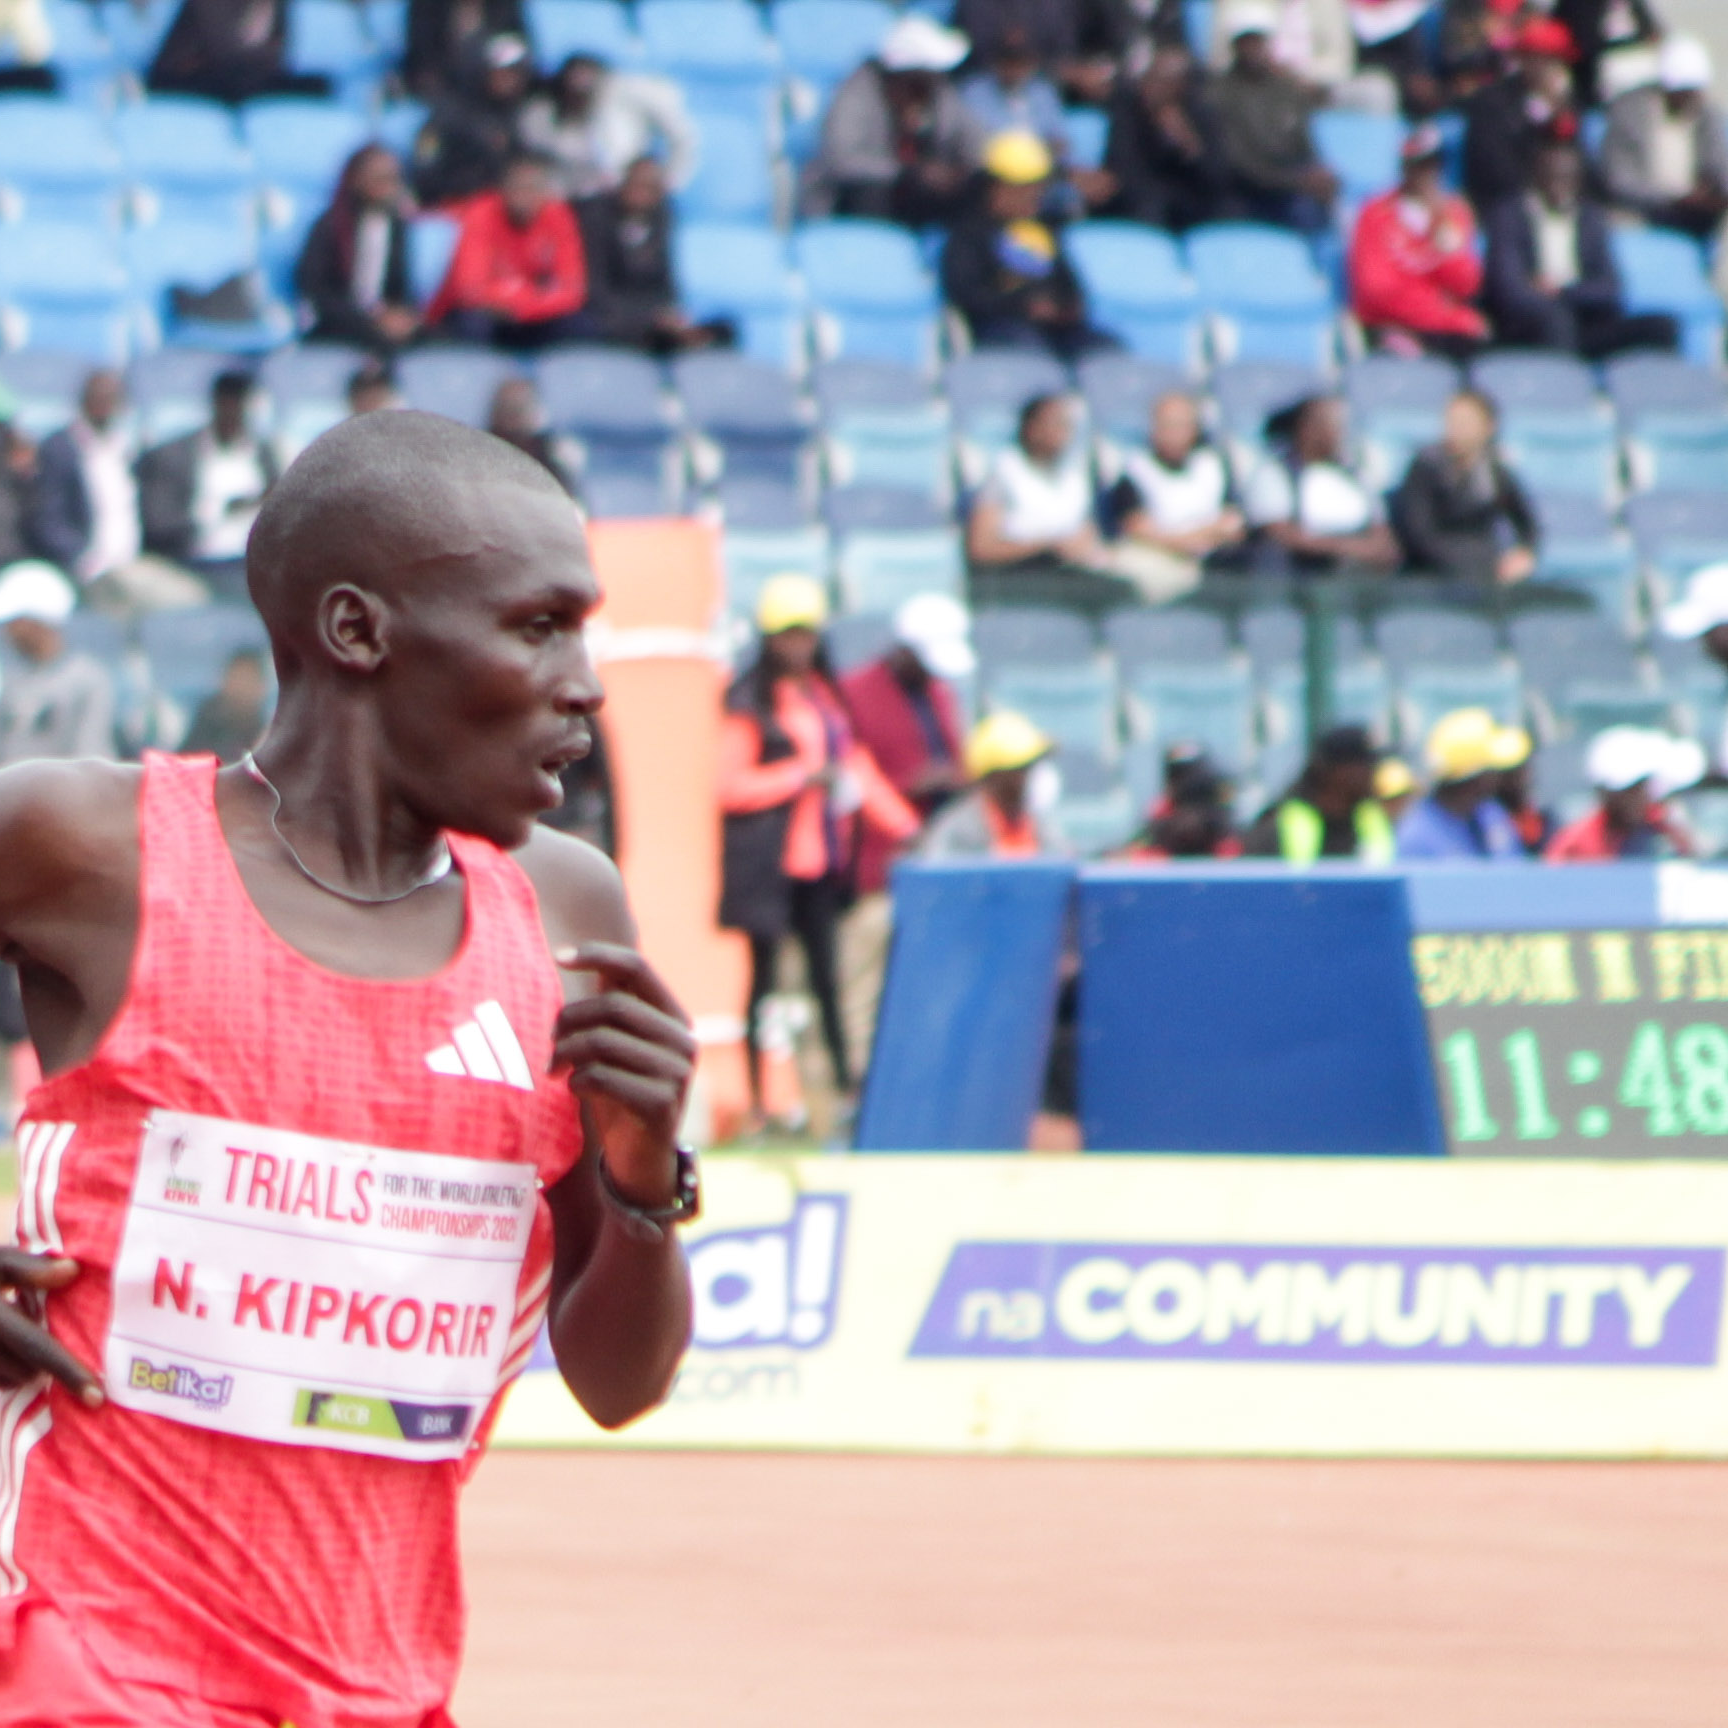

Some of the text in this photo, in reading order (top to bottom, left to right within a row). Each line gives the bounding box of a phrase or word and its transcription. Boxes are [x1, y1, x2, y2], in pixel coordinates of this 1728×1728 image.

[225, 1146, 375, 1225] TRIALS
[383, 1173, 408, 1197] FOR
[411, 1176, 437, 1200] THE
[153, 1258, 497, 1358] N. KIPKORIR
[955, 1256, 1695, 1351] na COMMUNITY
[128, 1356, 234, 1406] Betika!
[329, 1402, 370, 1426] KCB
